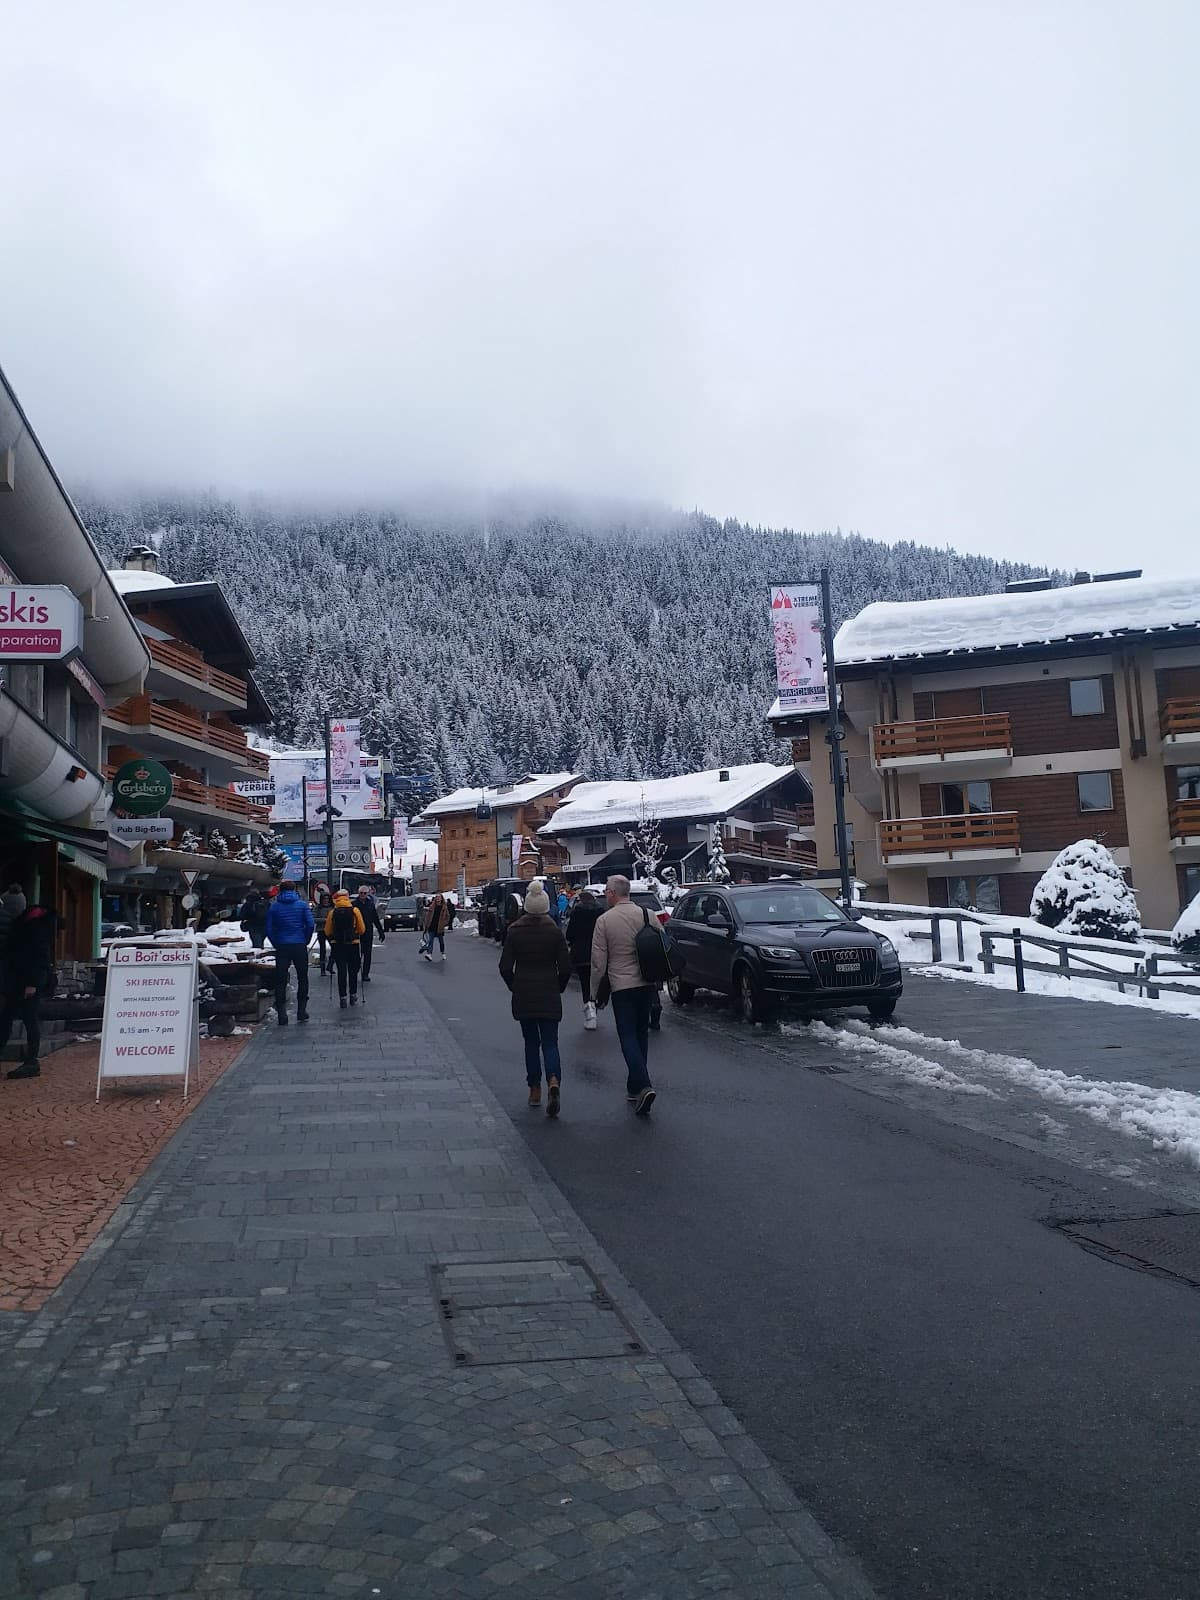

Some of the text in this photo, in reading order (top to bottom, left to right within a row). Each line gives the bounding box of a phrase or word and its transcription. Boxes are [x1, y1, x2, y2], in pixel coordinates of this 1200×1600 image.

[0, 634, 59, 649] paration
[117, 780, 167, 796] Carlsberg
[237, 783, 276, 792] VERBIER
[115, 951, 130, 963] La
[126, 978, 176, 987] SKI RENTAL
[140, 1009, 180, 1017] NON-STOP
[115, 1045, 176, 1057] WELCOME
